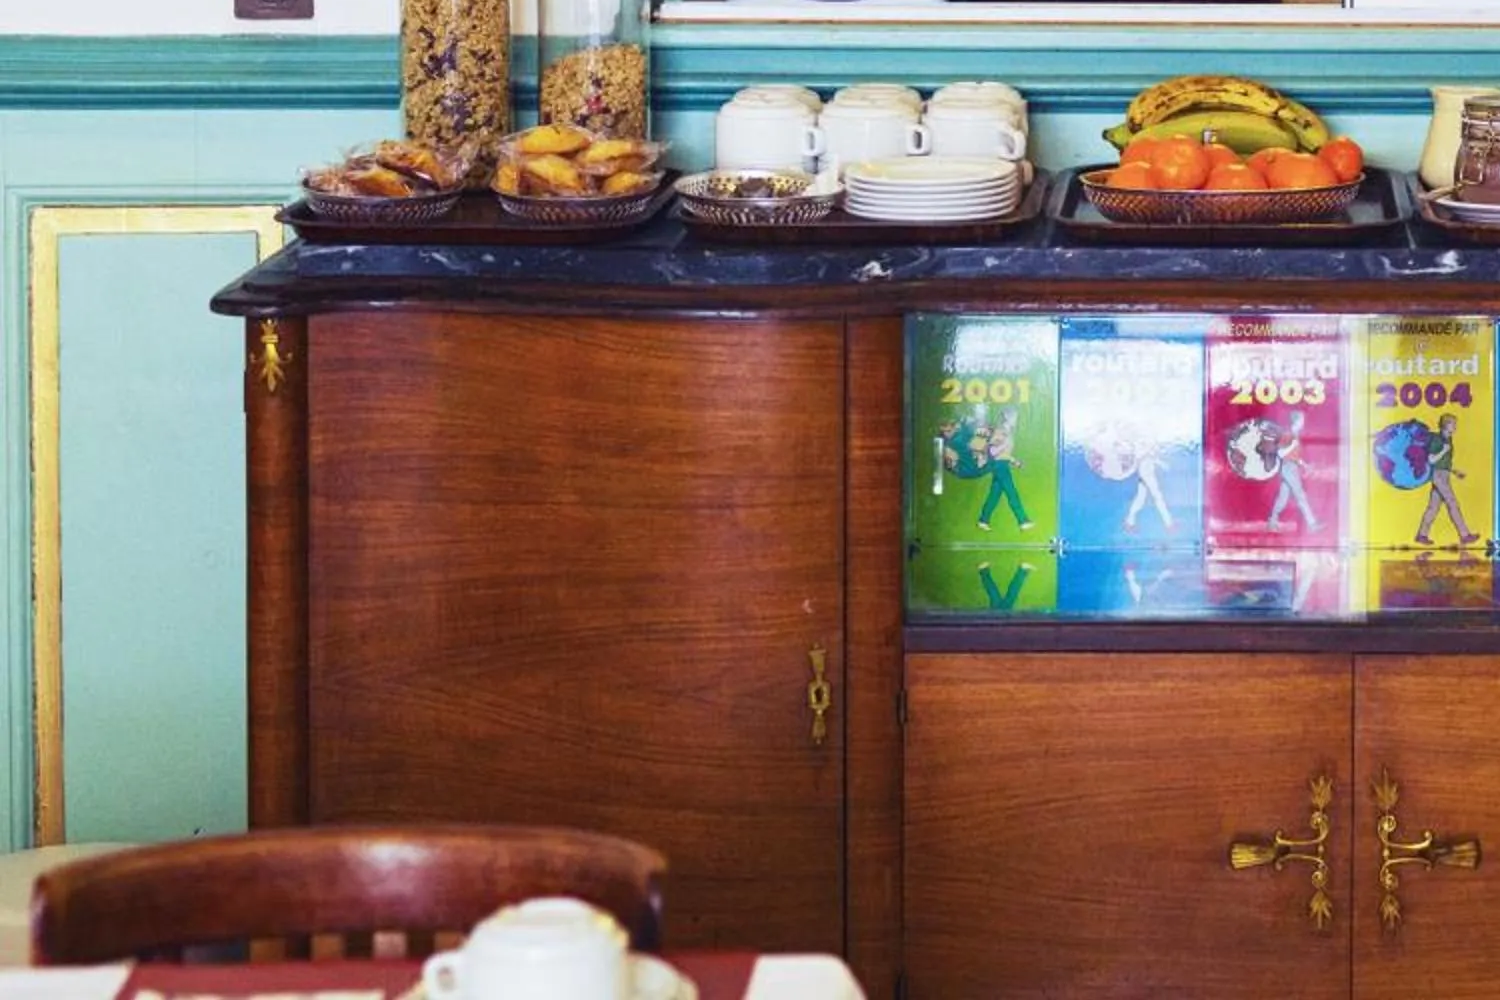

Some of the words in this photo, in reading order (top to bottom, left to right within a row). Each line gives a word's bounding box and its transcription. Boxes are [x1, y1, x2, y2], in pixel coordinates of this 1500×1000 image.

[941, 377, 1030, 404] 2001
[1229, 378, 1326, 405] 2003
[1375, 382, 1473, 408] 2004
